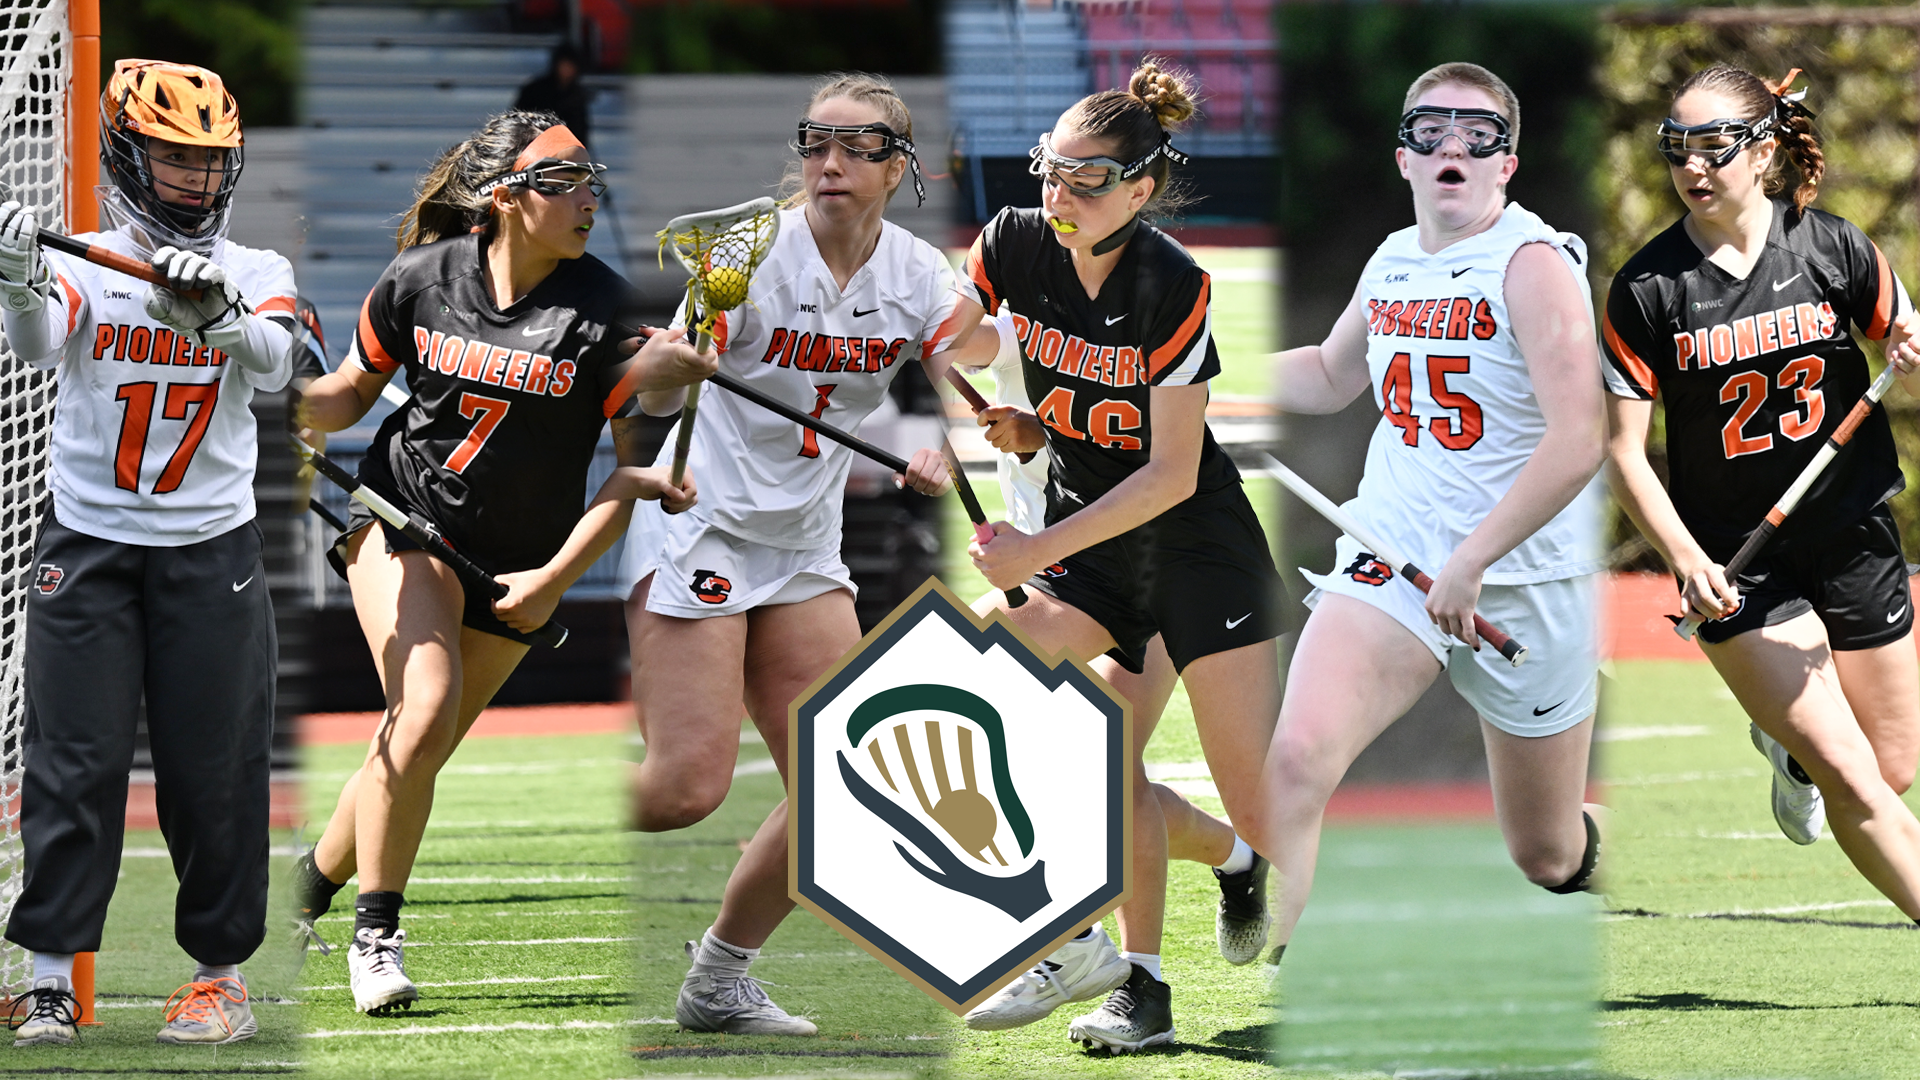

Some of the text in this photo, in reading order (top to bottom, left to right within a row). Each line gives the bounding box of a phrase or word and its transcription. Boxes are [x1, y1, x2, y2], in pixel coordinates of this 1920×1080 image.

[1752, 115, 1772, 137] STX
[502, 172, 528, 186] GAIT
[1123, 161, 1143, 178] GAIT
[1145, 146, 1161, 164] GAIT
[111, 291, 131, 300] NWC
[1368, 297, 1497, 340] PIONEERS
[1701, 299, 1724, 310] NWC
[414, 325, 577, 397] PIONEERS
[761, 327, 908, 374] PIONEERS
[1673, 301, 1837, 371] PIONEERS
[441, 391, 511, 475] 7
[797, 384, 838, 459] 1
[1036, 385, 1142, 450] 46
[1382, 352, 1484, 451] 45
[1719, 354, 1825, 460] 23
[114, 377, 221, 495] 17
